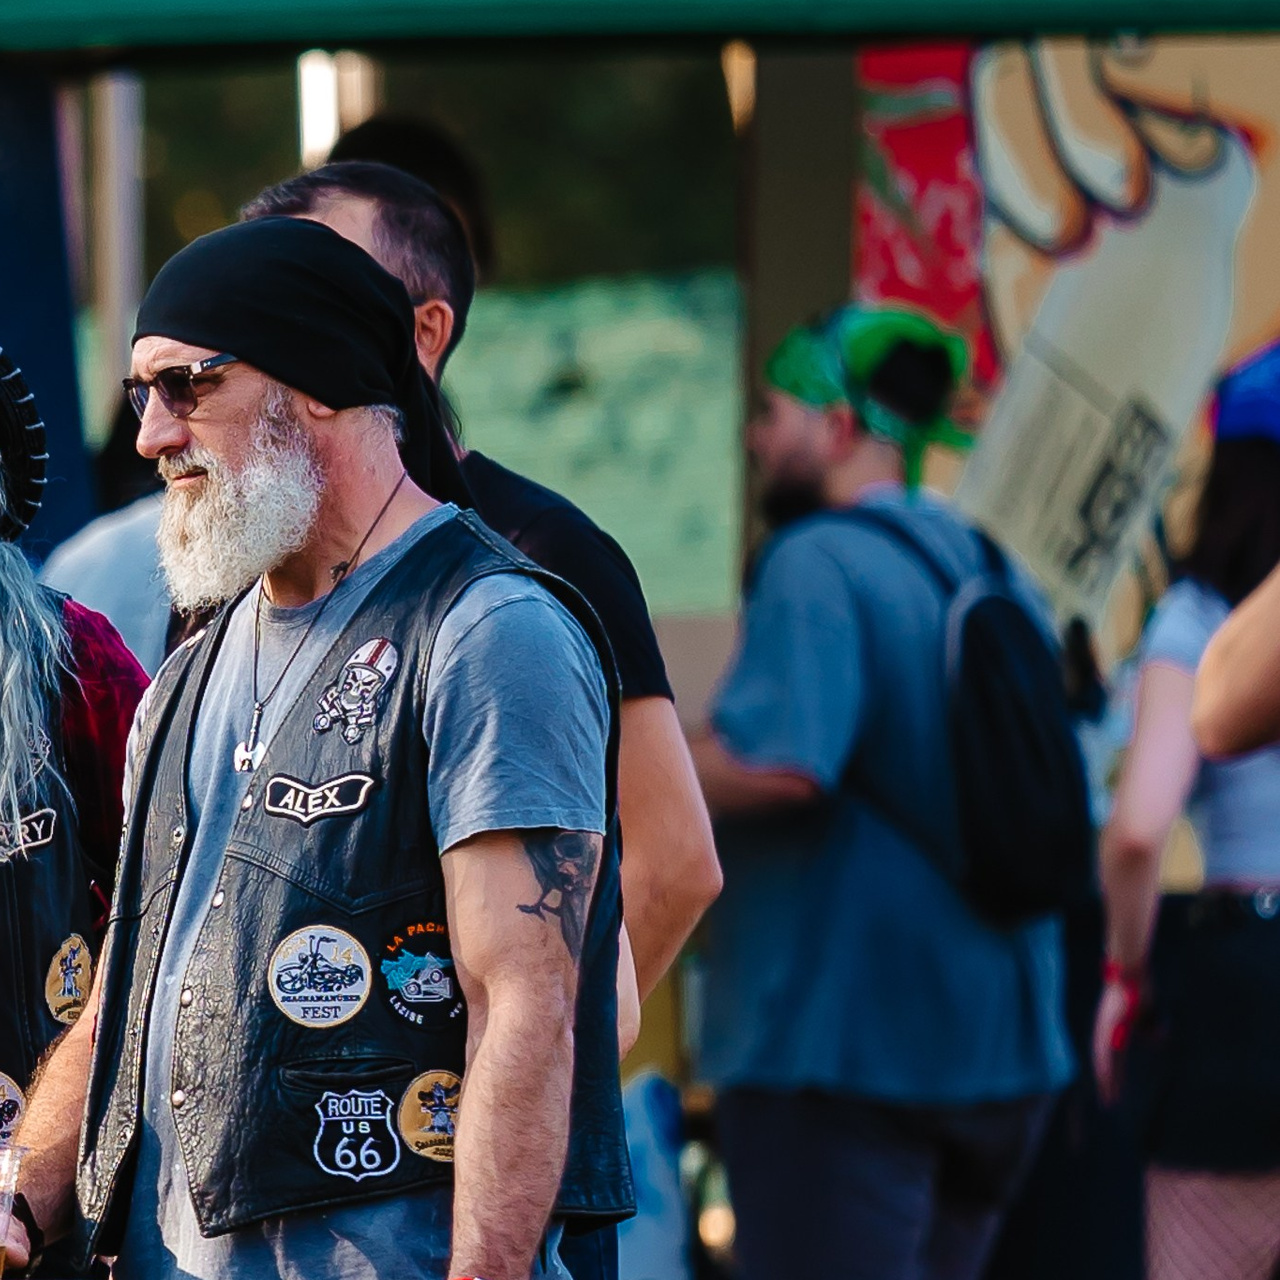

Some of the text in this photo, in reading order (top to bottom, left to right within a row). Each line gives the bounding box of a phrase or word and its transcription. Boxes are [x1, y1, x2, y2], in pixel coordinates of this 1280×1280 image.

[278, 786, 342, 814] ALEX
[406, 922, 446, 936] PACH
[301, 1006, 341, 1019] FEST
[327, 1097, 383, 1117] ROUTE
[341, 1121, 371, 1134] US
[334, 1136, 382, 1170] 66
